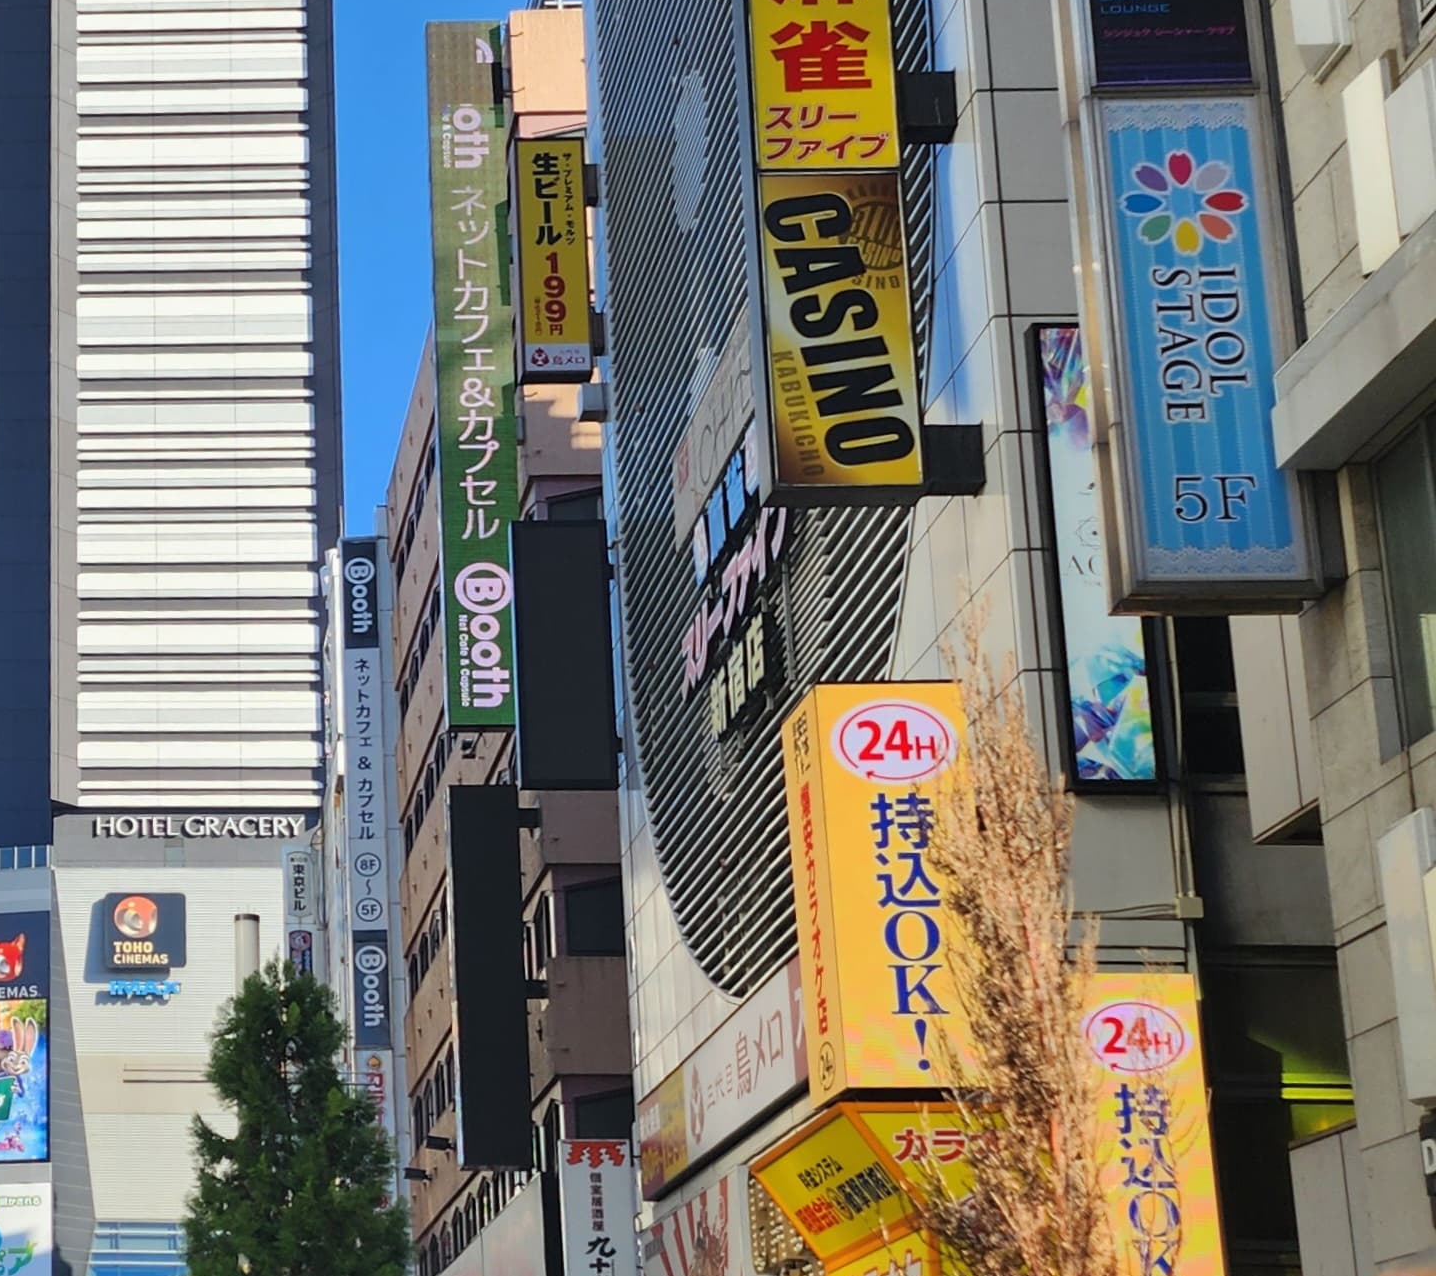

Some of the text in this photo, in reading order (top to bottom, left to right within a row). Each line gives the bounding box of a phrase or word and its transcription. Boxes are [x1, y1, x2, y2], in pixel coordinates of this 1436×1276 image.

[764, 133, 890, 165] ファイブ
[765, 104, 858, 131] スリー
[531, 152, 562, 246] 生ビール
[543, 252, 568, 336] 199円
[765, 192, 915, 467] CASINO
[451, 185, 500, 539] ネットカフェ&カプセル
[1152, 265, 1250, 425] IDOL STAGE
[772, 349, 825, 478] KABUKICHO
[1172, 473, 1260, 524] 5F
[454, 561, 514, 708] Booth
[856, 719, 937, 763] 24H
[95, 814, 306, 837] HOTEL GRACERY
[292, 863, 307, 912] 東京ビル
[113, 941, 154, 953] TOHO
[113, 953, 169, 965] CINEMAS
[869, 791, 951, 1073] 持込OK!
[355, 945, 387, 1028] Booth
